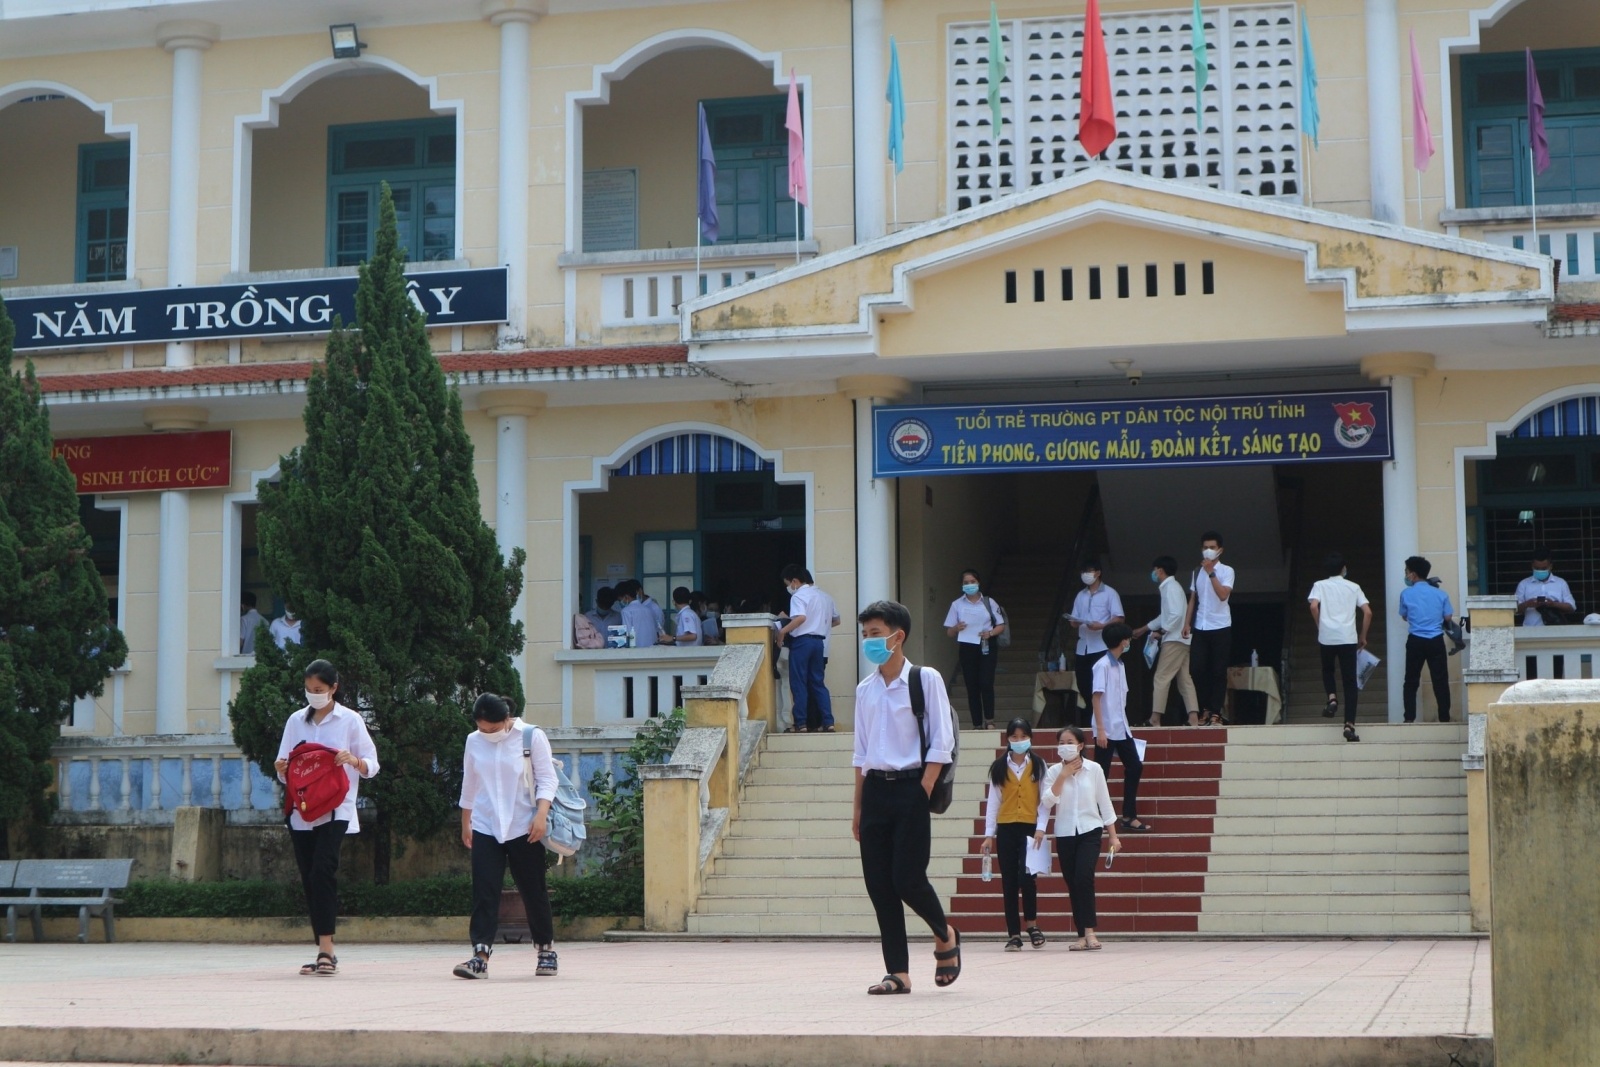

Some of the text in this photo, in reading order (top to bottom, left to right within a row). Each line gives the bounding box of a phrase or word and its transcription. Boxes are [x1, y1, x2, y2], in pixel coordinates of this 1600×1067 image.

[32, 280, 462, 339] NĂM TRỒNG ÂY
[955, 400, 1305, 430] TUỔI TRẺ TRƯỜNG PT DÂN TỘC NỘI TRÚ TỈNH
[942, 424, 1321, 465] TIÊN PHONG, GƯƠNG MẪU, ĐOÀN KẾT, SÁNG TẠO
[81, 471, 123, 486] SINH
[129, 466, 171, 484] TÍCH
